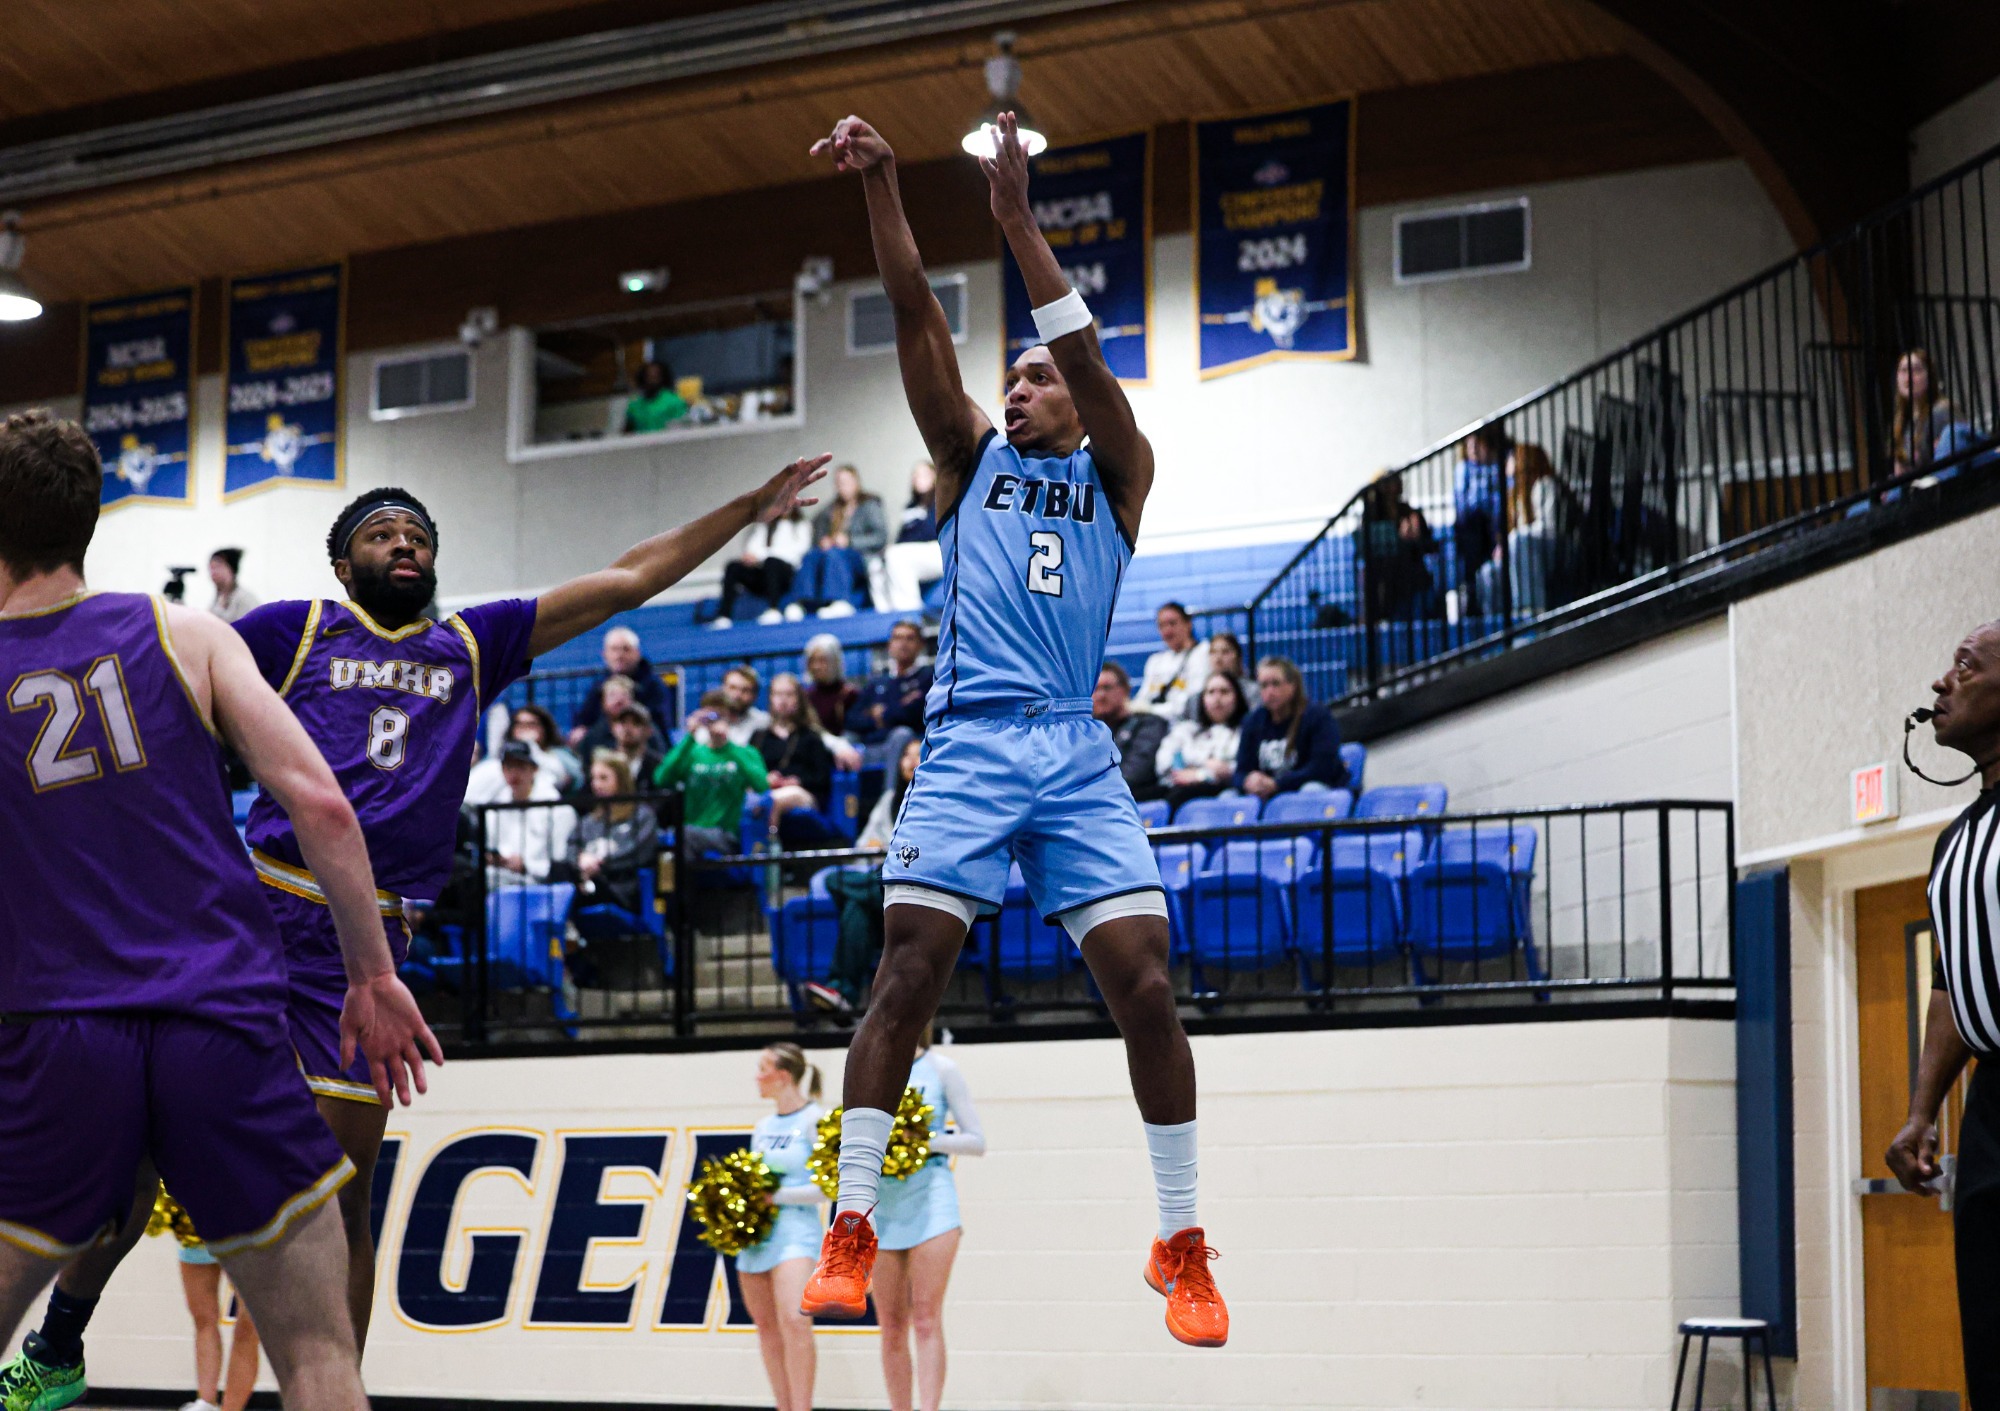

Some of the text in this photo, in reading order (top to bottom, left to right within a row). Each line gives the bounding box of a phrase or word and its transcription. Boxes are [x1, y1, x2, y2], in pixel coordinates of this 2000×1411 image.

[1238, 232, 1307, 272] 2024
[983, 473, 1096, 524] ETBU
[1028, 530, 1064, 598] 2
[330, 656, 454, 704] UMHB
[7, 653, 148, 795] 21
[366, 705, 410, 771] 8
